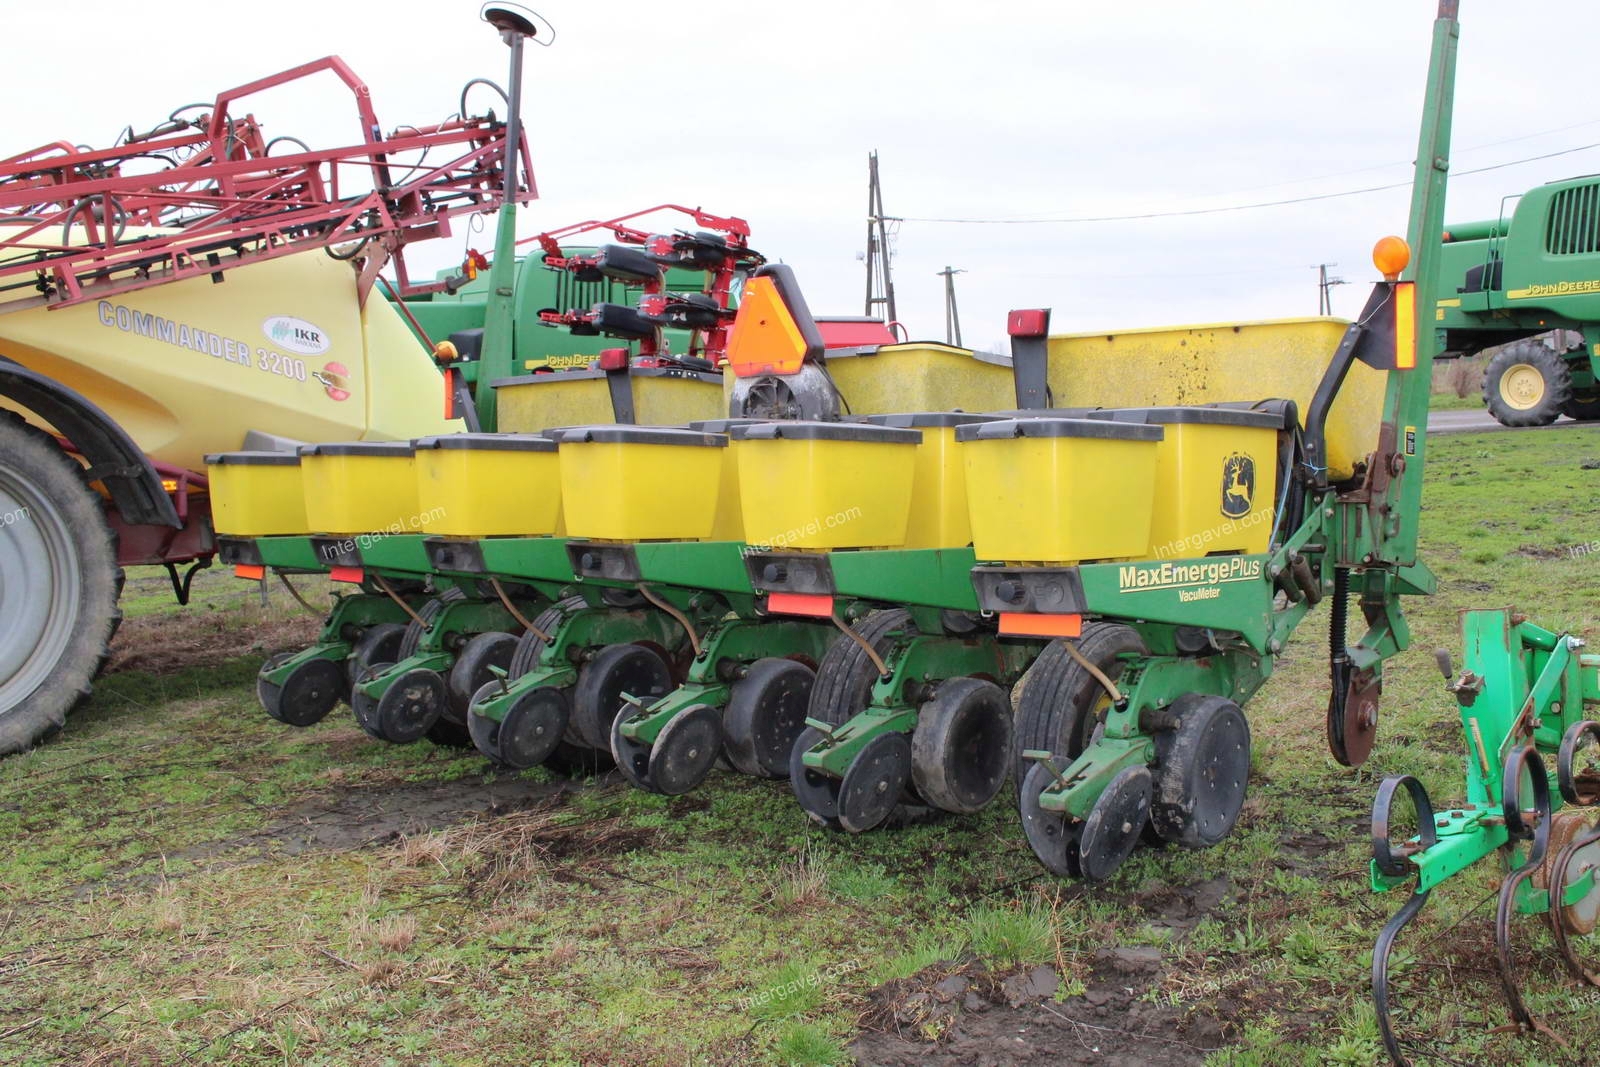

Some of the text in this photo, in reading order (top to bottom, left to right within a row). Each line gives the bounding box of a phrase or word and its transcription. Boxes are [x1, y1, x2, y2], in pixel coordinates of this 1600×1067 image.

[98, 300, 307, 382] COMMANDER 3200
[295, 327, 320, 343] IKR
[1179, 587, 1221, 602] VacuMeter
